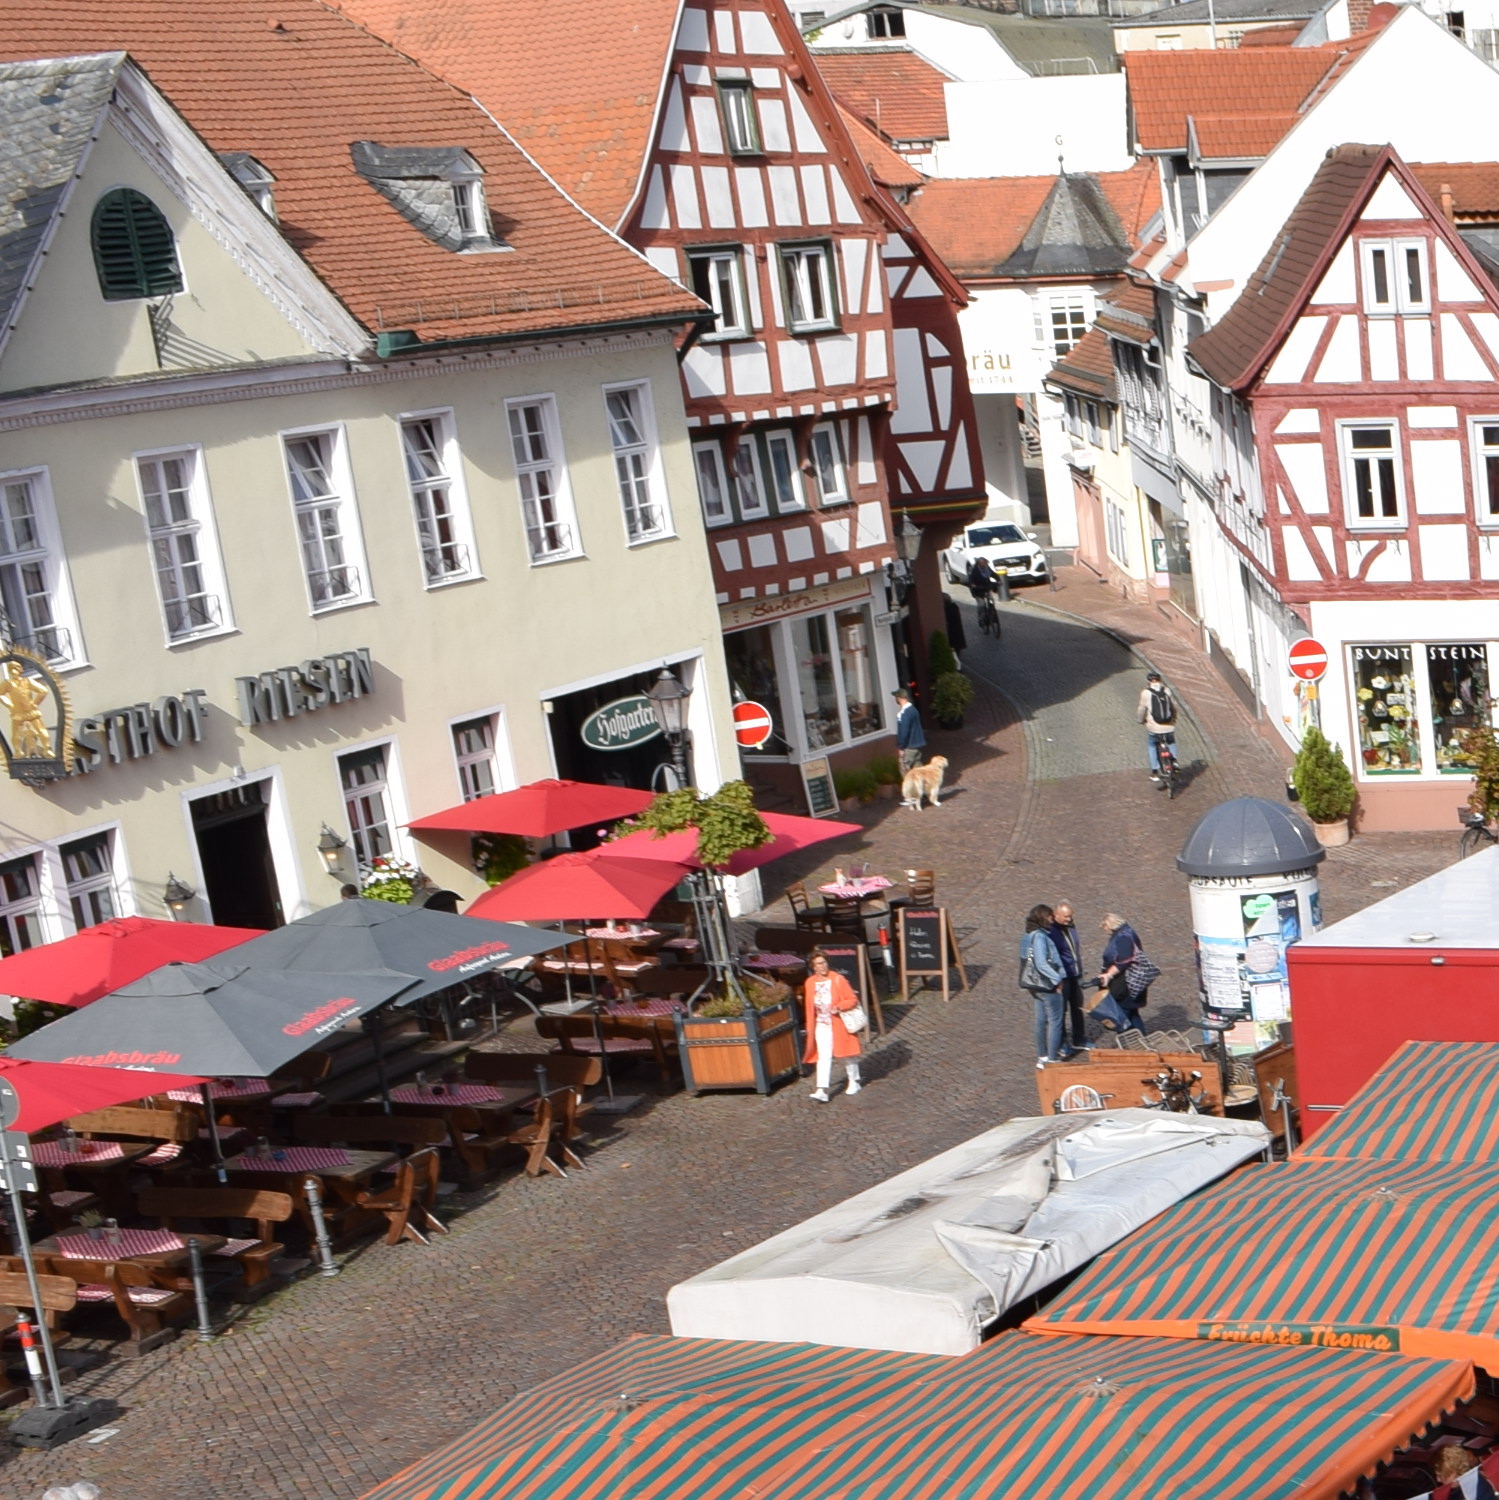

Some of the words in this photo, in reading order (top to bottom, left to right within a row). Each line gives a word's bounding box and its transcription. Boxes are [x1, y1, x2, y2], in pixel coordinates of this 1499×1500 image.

[1354, 647, 1411, 661] BUNT
[1429, 646, 1485, 661] STEIN
[234, 647, 375, 727] RIESEN
[1208, 1323, 1302, 1345] Früchte
[1310, 1326, 1392, 1350] Thoma
